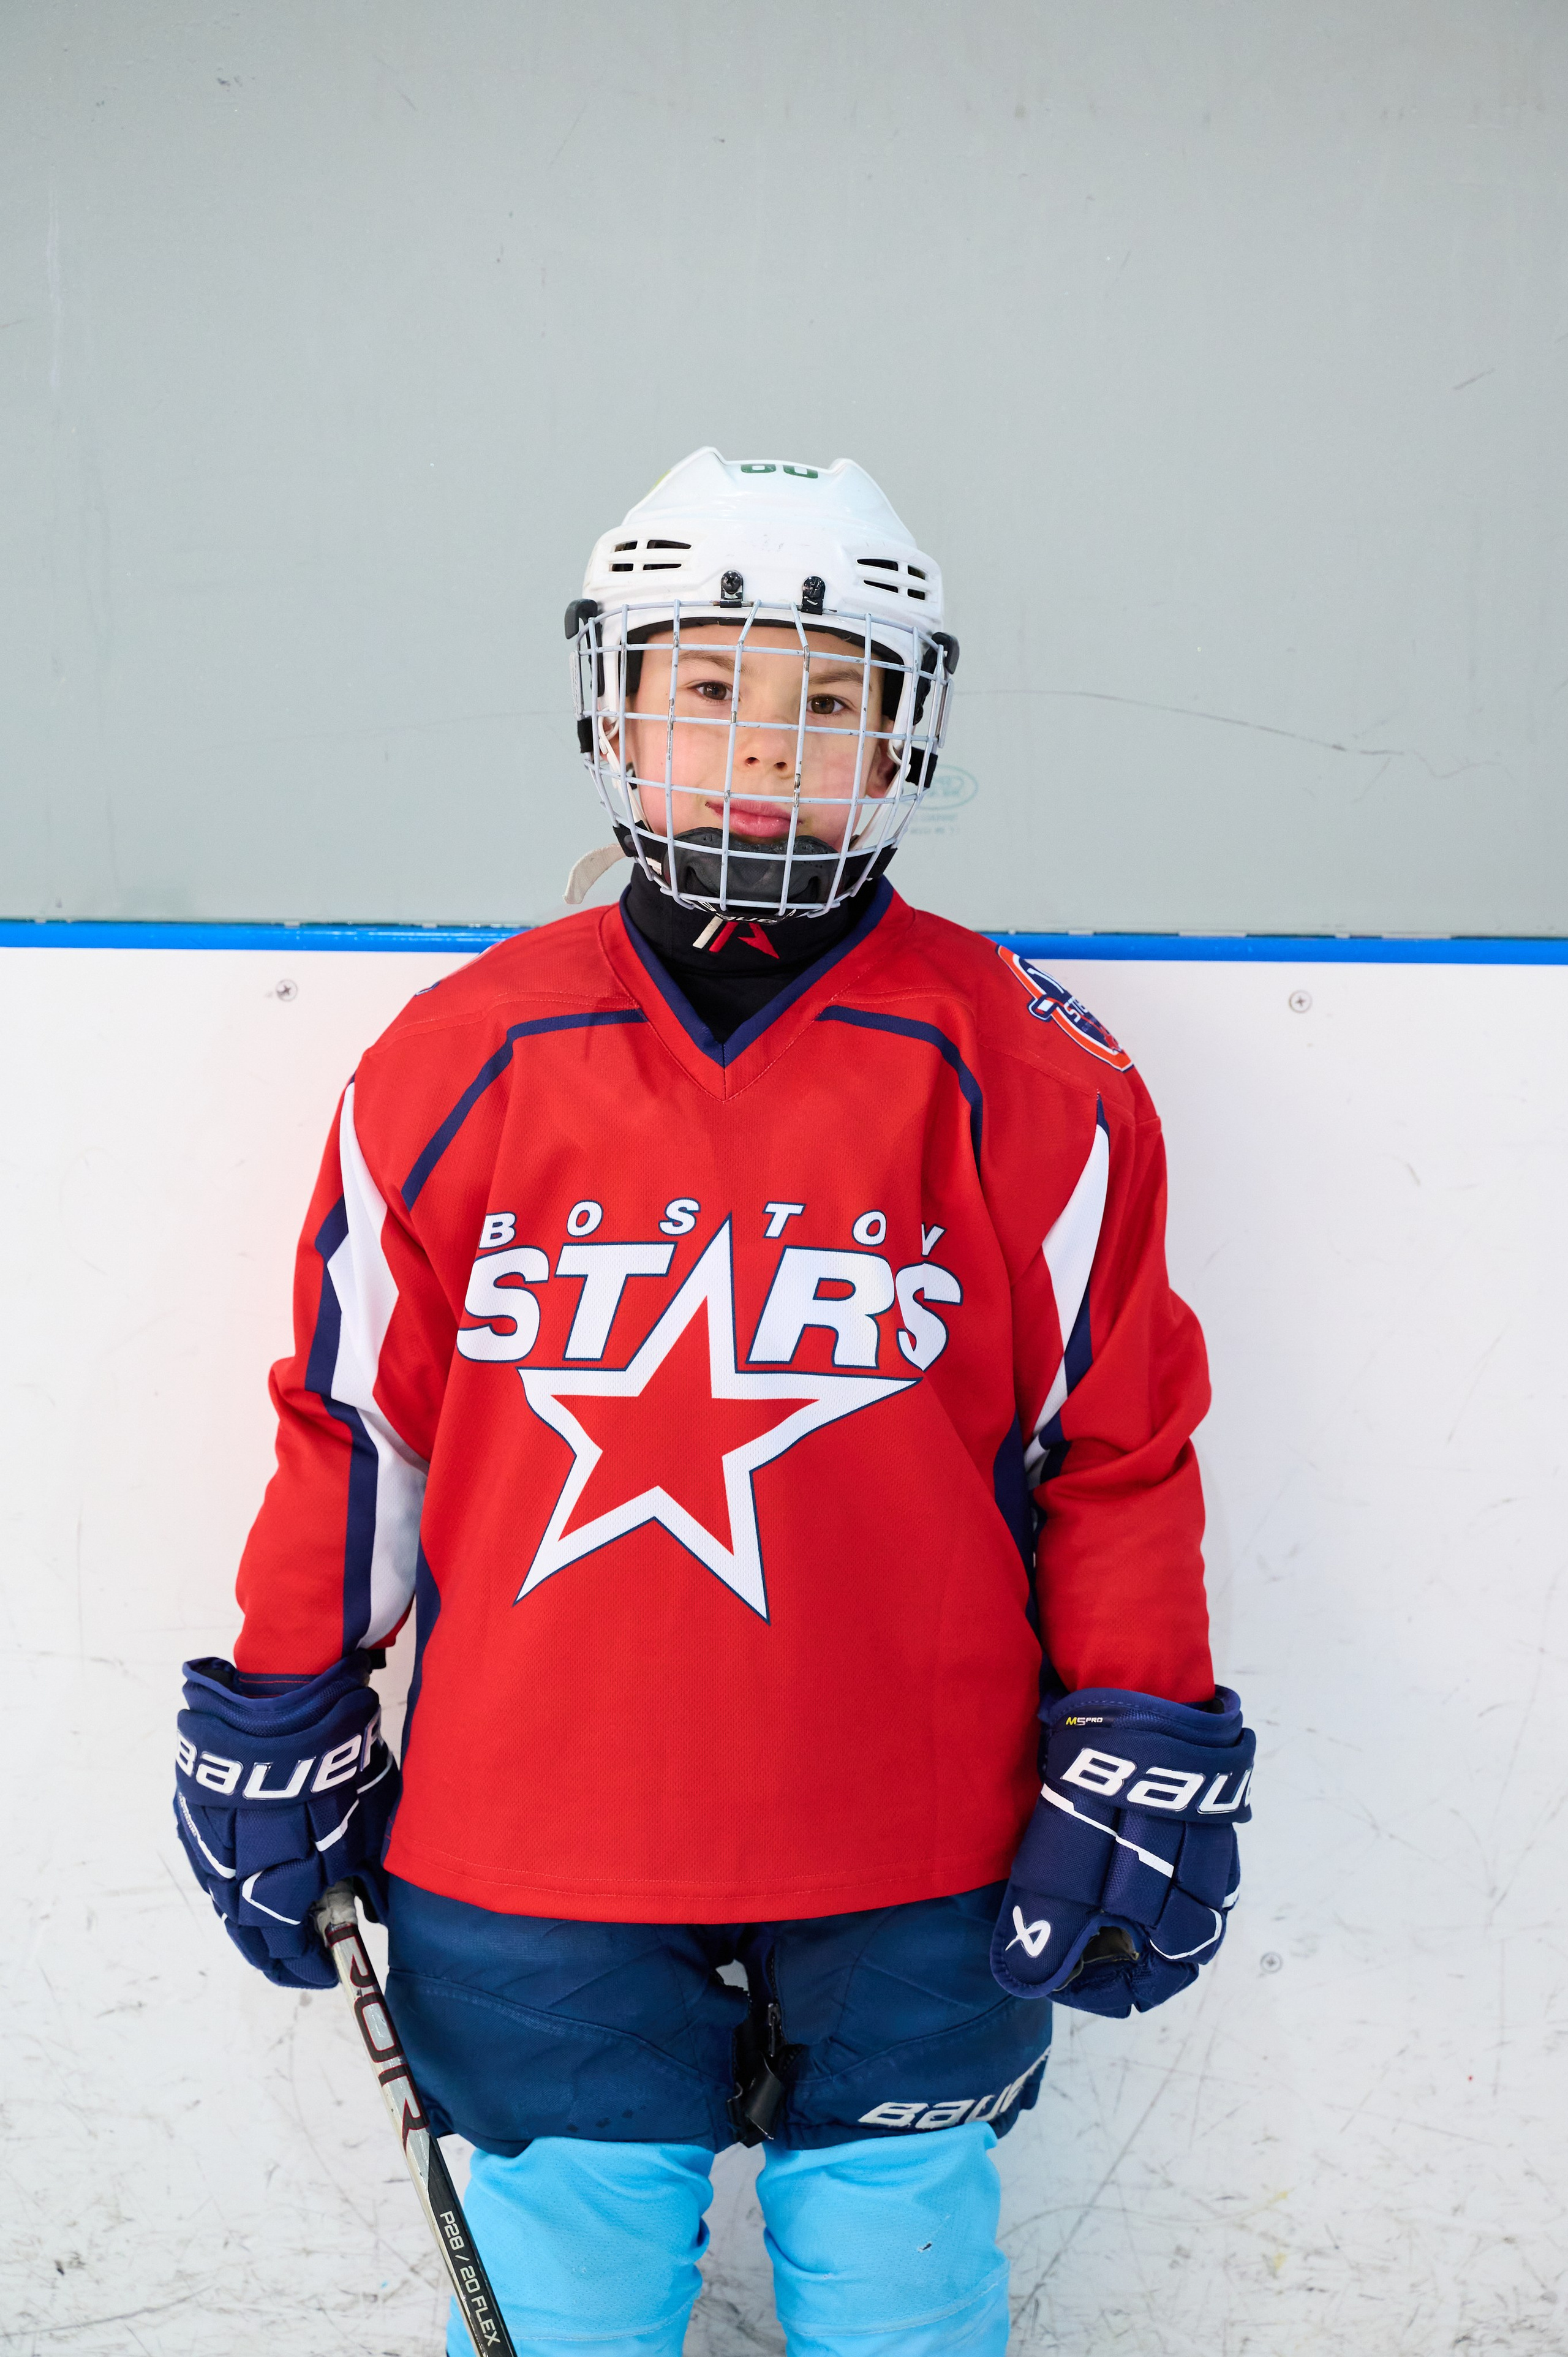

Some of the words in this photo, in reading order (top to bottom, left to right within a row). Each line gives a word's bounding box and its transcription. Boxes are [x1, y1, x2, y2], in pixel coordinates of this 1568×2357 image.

[1061, 1748, 1251, 1814] Bau
[440, 2211, 465, 2250] P28
[460, 2266, 481, 2294] 20
[471, 2295, 501, 2347] FLEX
